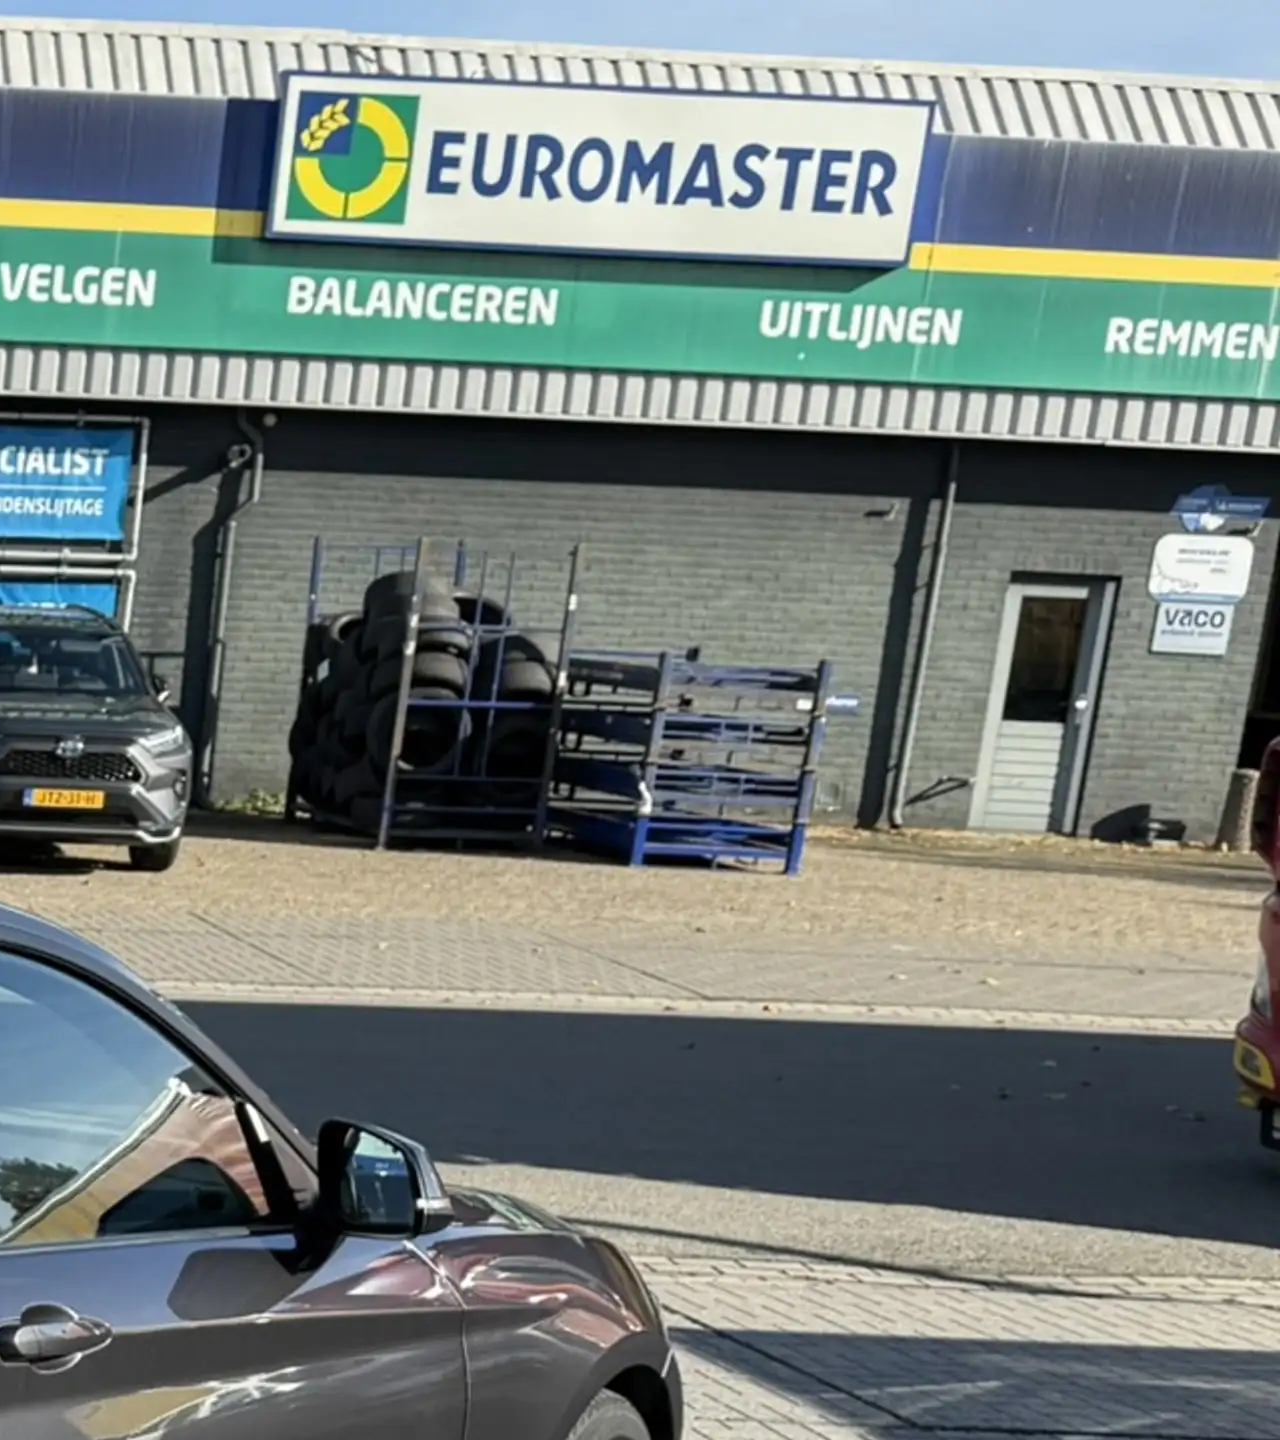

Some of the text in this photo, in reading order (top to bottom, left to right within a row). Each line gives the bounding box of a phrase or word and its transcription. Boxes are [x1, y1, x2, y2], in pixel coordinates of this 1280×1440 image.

[425, 130, 898, 217] EUROMASTER
[0, 262, 157, 308] VELGEN
[286, 275, 559, 327] BALANCEREN
[759, 299, 962, 350] UITLIJNEN
[1104, 316, 1280, 361] REMMEN
